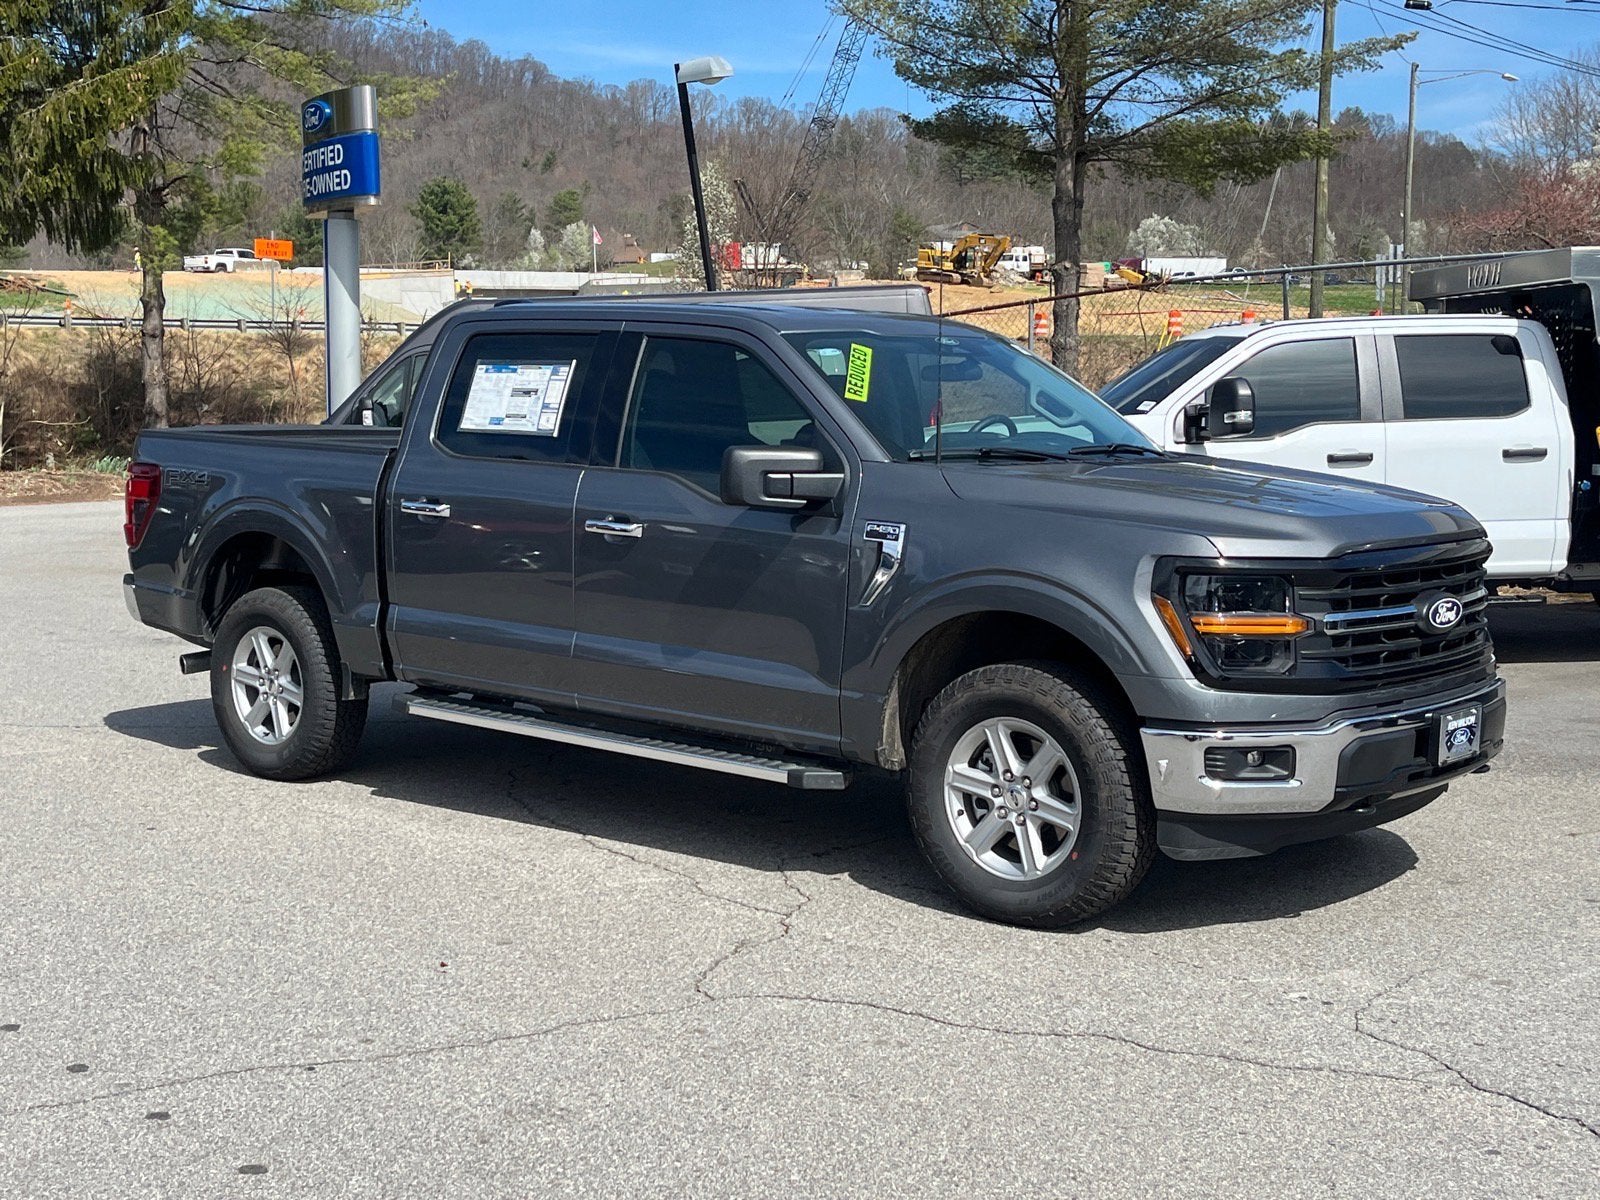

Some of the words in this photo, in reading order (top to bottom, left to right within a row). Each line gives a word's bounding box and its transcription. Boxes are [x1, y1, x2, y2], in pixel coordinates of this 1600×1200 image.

[304, 107, 320, 129] Ford
[303, 143, 344, 173] ERTIFIED
[847, 347, 867, 397] REDUCED
[164, 468, 208, 486] FX4
[1435, 602, 1457, 624] Ford
